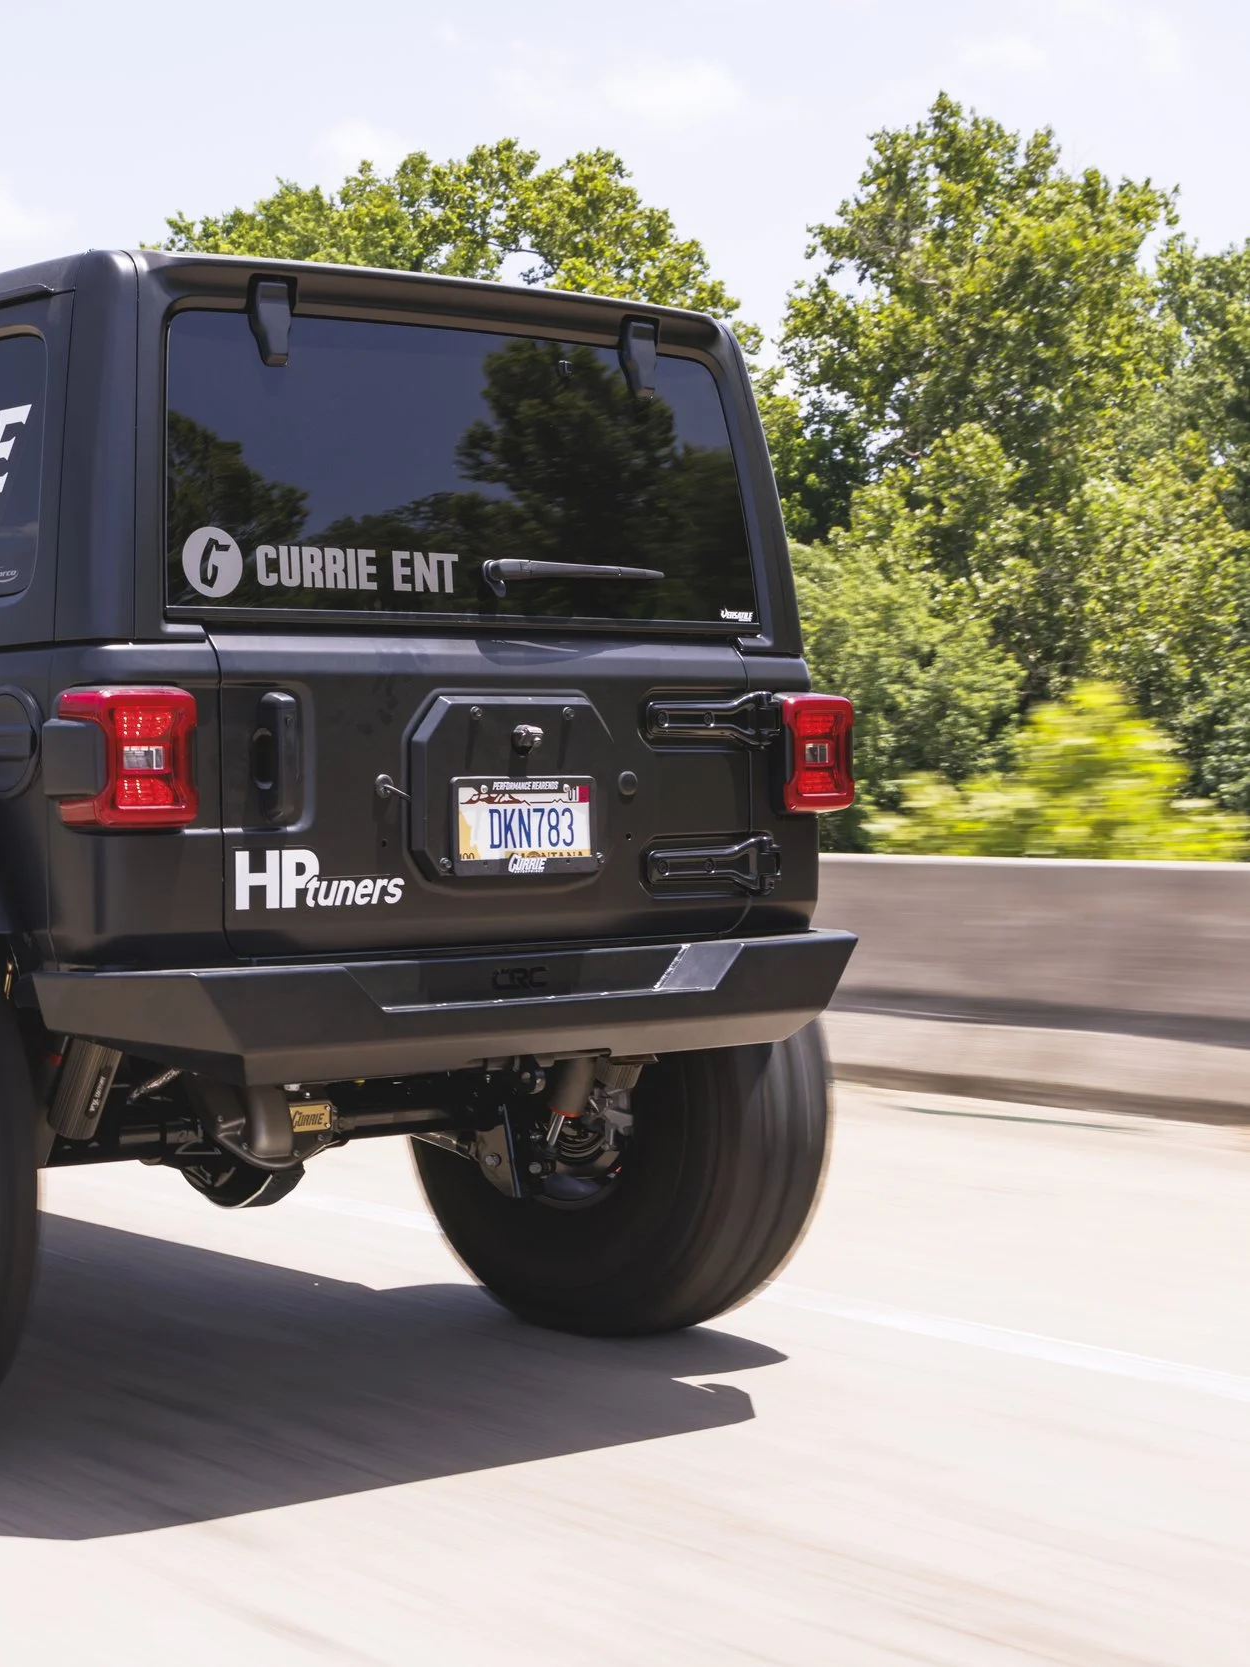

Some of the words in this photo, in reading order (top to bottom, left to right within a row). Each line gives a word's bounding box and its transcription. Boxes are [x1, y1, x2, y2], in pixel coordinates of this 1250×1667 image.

[255, 544, 379, 592] CURRIE
[391, 550, 459, 594] ENT
[492, 781, 531, 791] PERFORMANCE
[531, 780, 559, 790] REARENDS
[488, 807, 575, 849] DKN783
[508, 854, 548, 873] CURRIE
[235, 849, 405, 911] HPtuners
[292, 1110, 326, 1128] CURRIE
